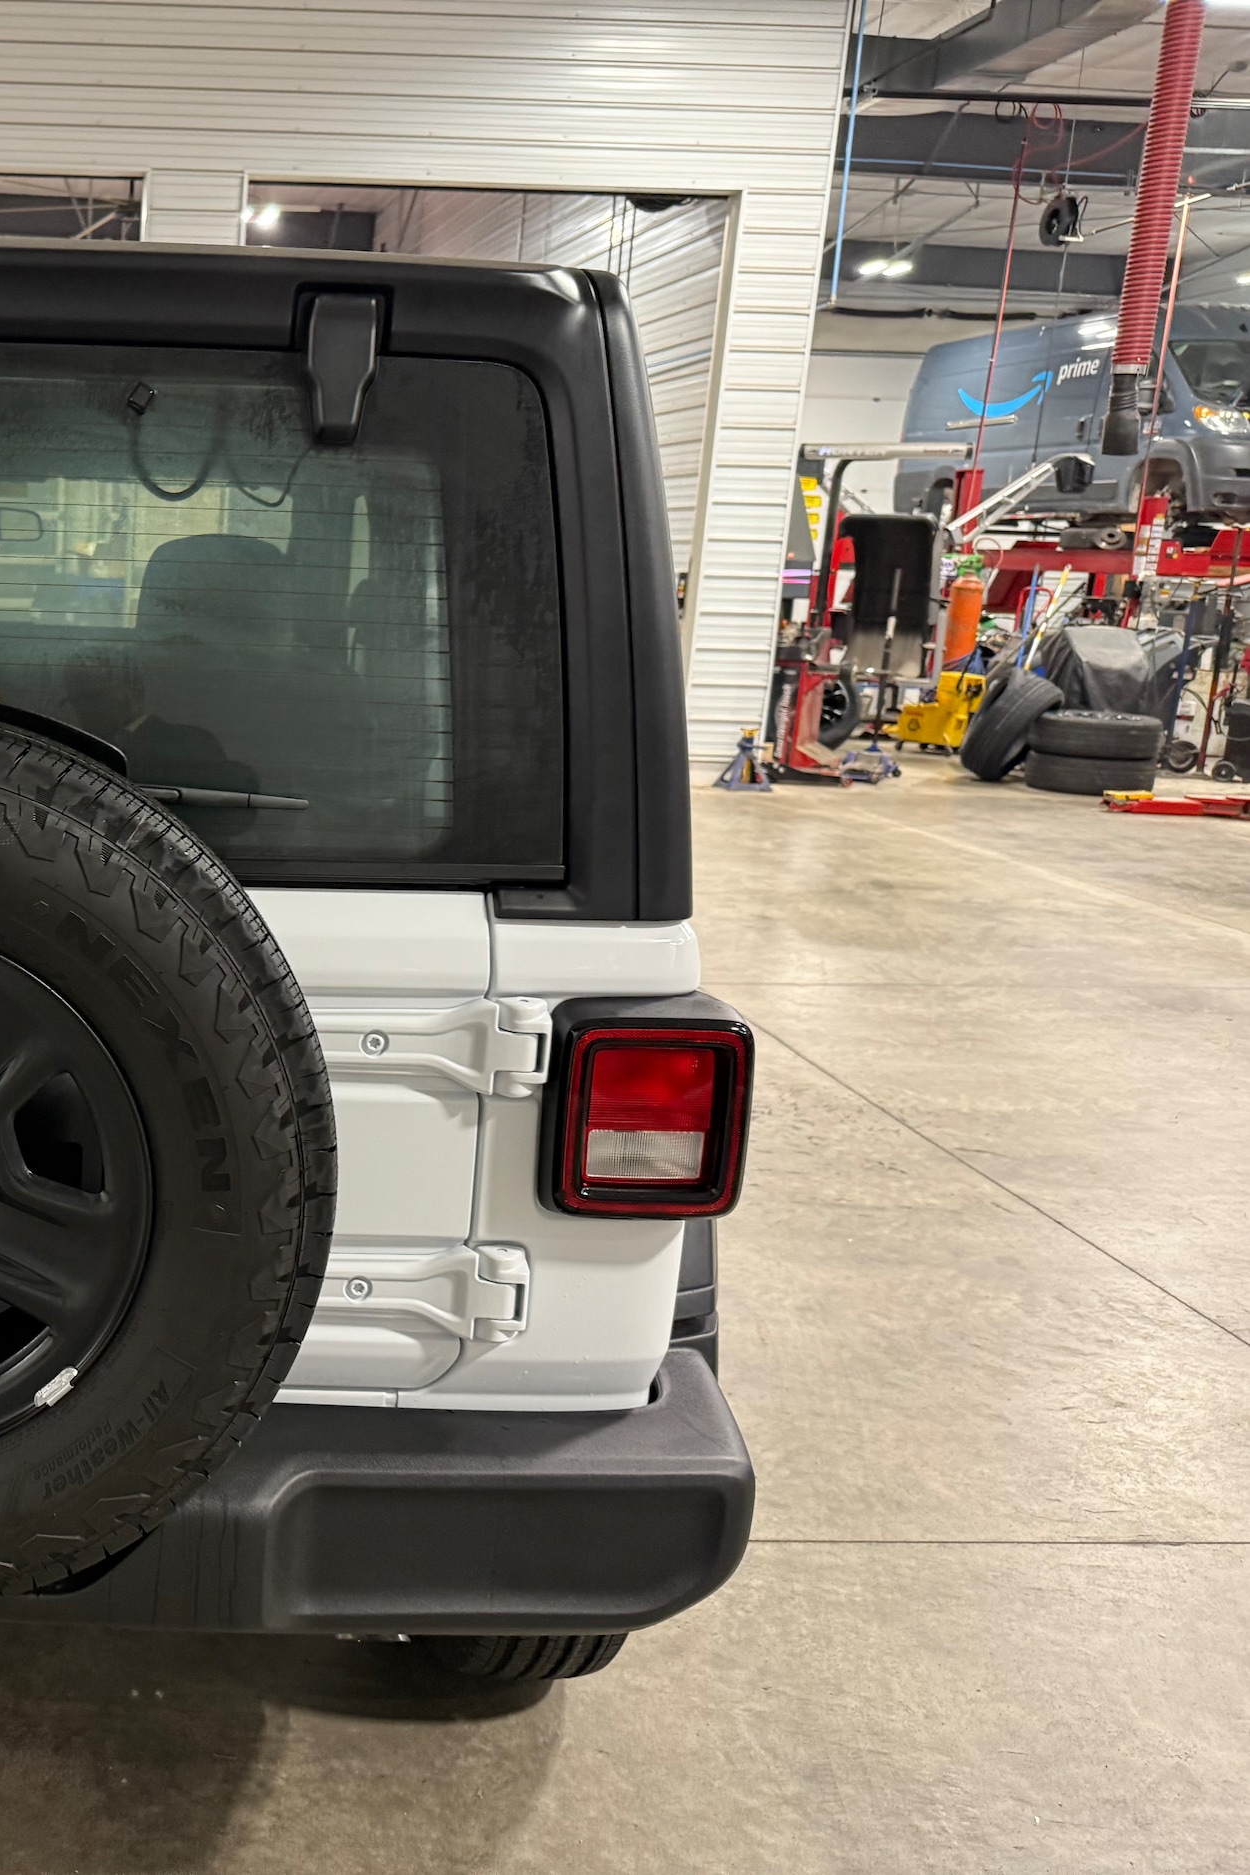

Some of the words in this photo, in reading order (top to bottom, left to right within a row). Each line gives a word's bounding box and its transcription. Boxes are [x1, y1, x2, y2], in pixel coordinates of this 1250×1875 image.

[1056, 357, 1100, 386] prime
[55, 910, 231, 1192] NEXEN
[32, 1418, 113, 1481] Performance
[43, 1379, 170, 1500] All-Weather
